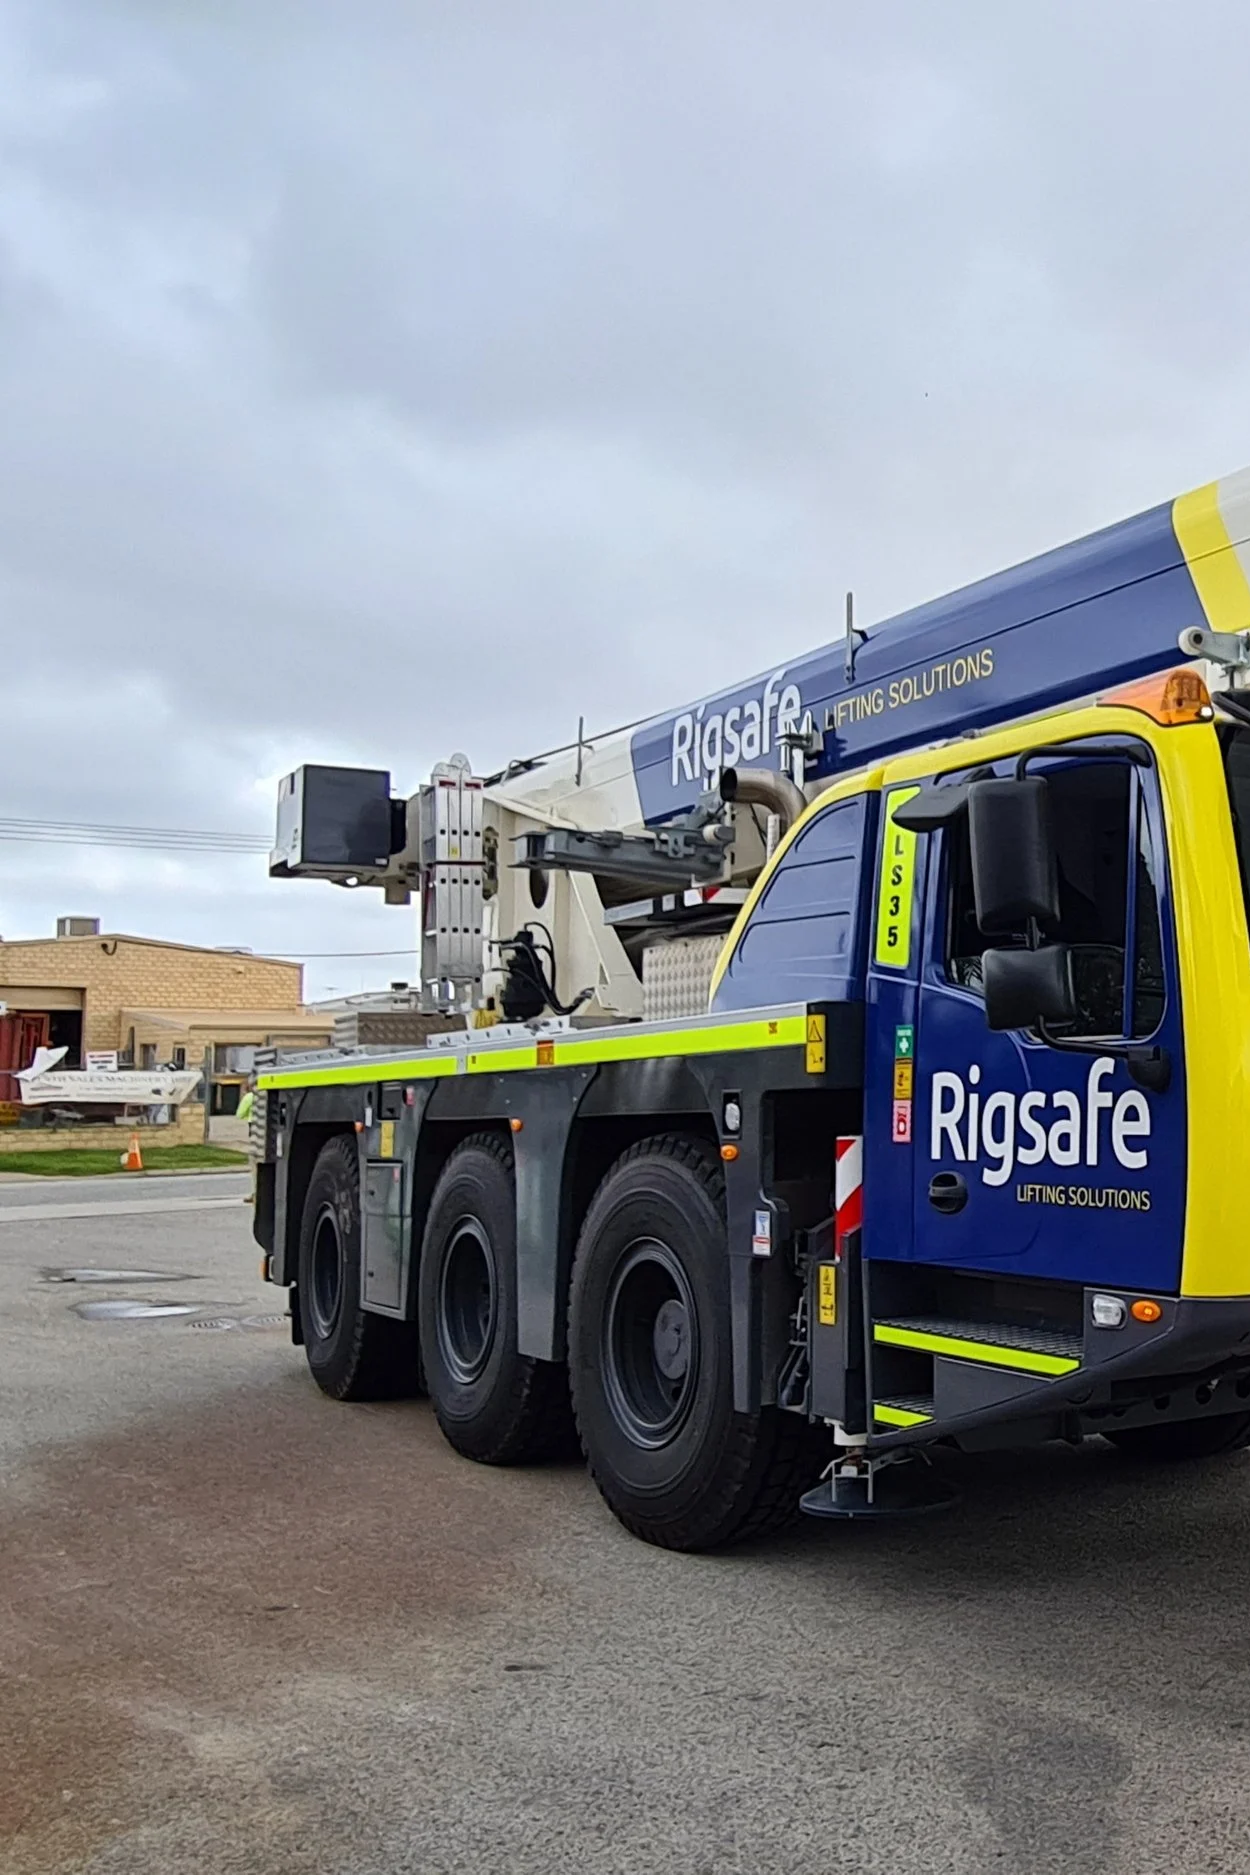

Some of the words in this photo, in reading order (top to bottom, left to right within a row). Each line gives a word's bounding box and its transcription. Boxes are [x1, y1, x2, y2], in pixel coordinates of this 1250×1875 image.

[672, 668, 801, 792] Rigsafe
[824, 687, 884, 730] LIFTING
[889, 648, 994, 709] SOLUTIONS
[930, 1056, 1151, 1187] Rigsafe
[1017, 1184, 1066, 1205] LIFTING
[1068, 1187, 1151, 1211] SOLUTIONS
